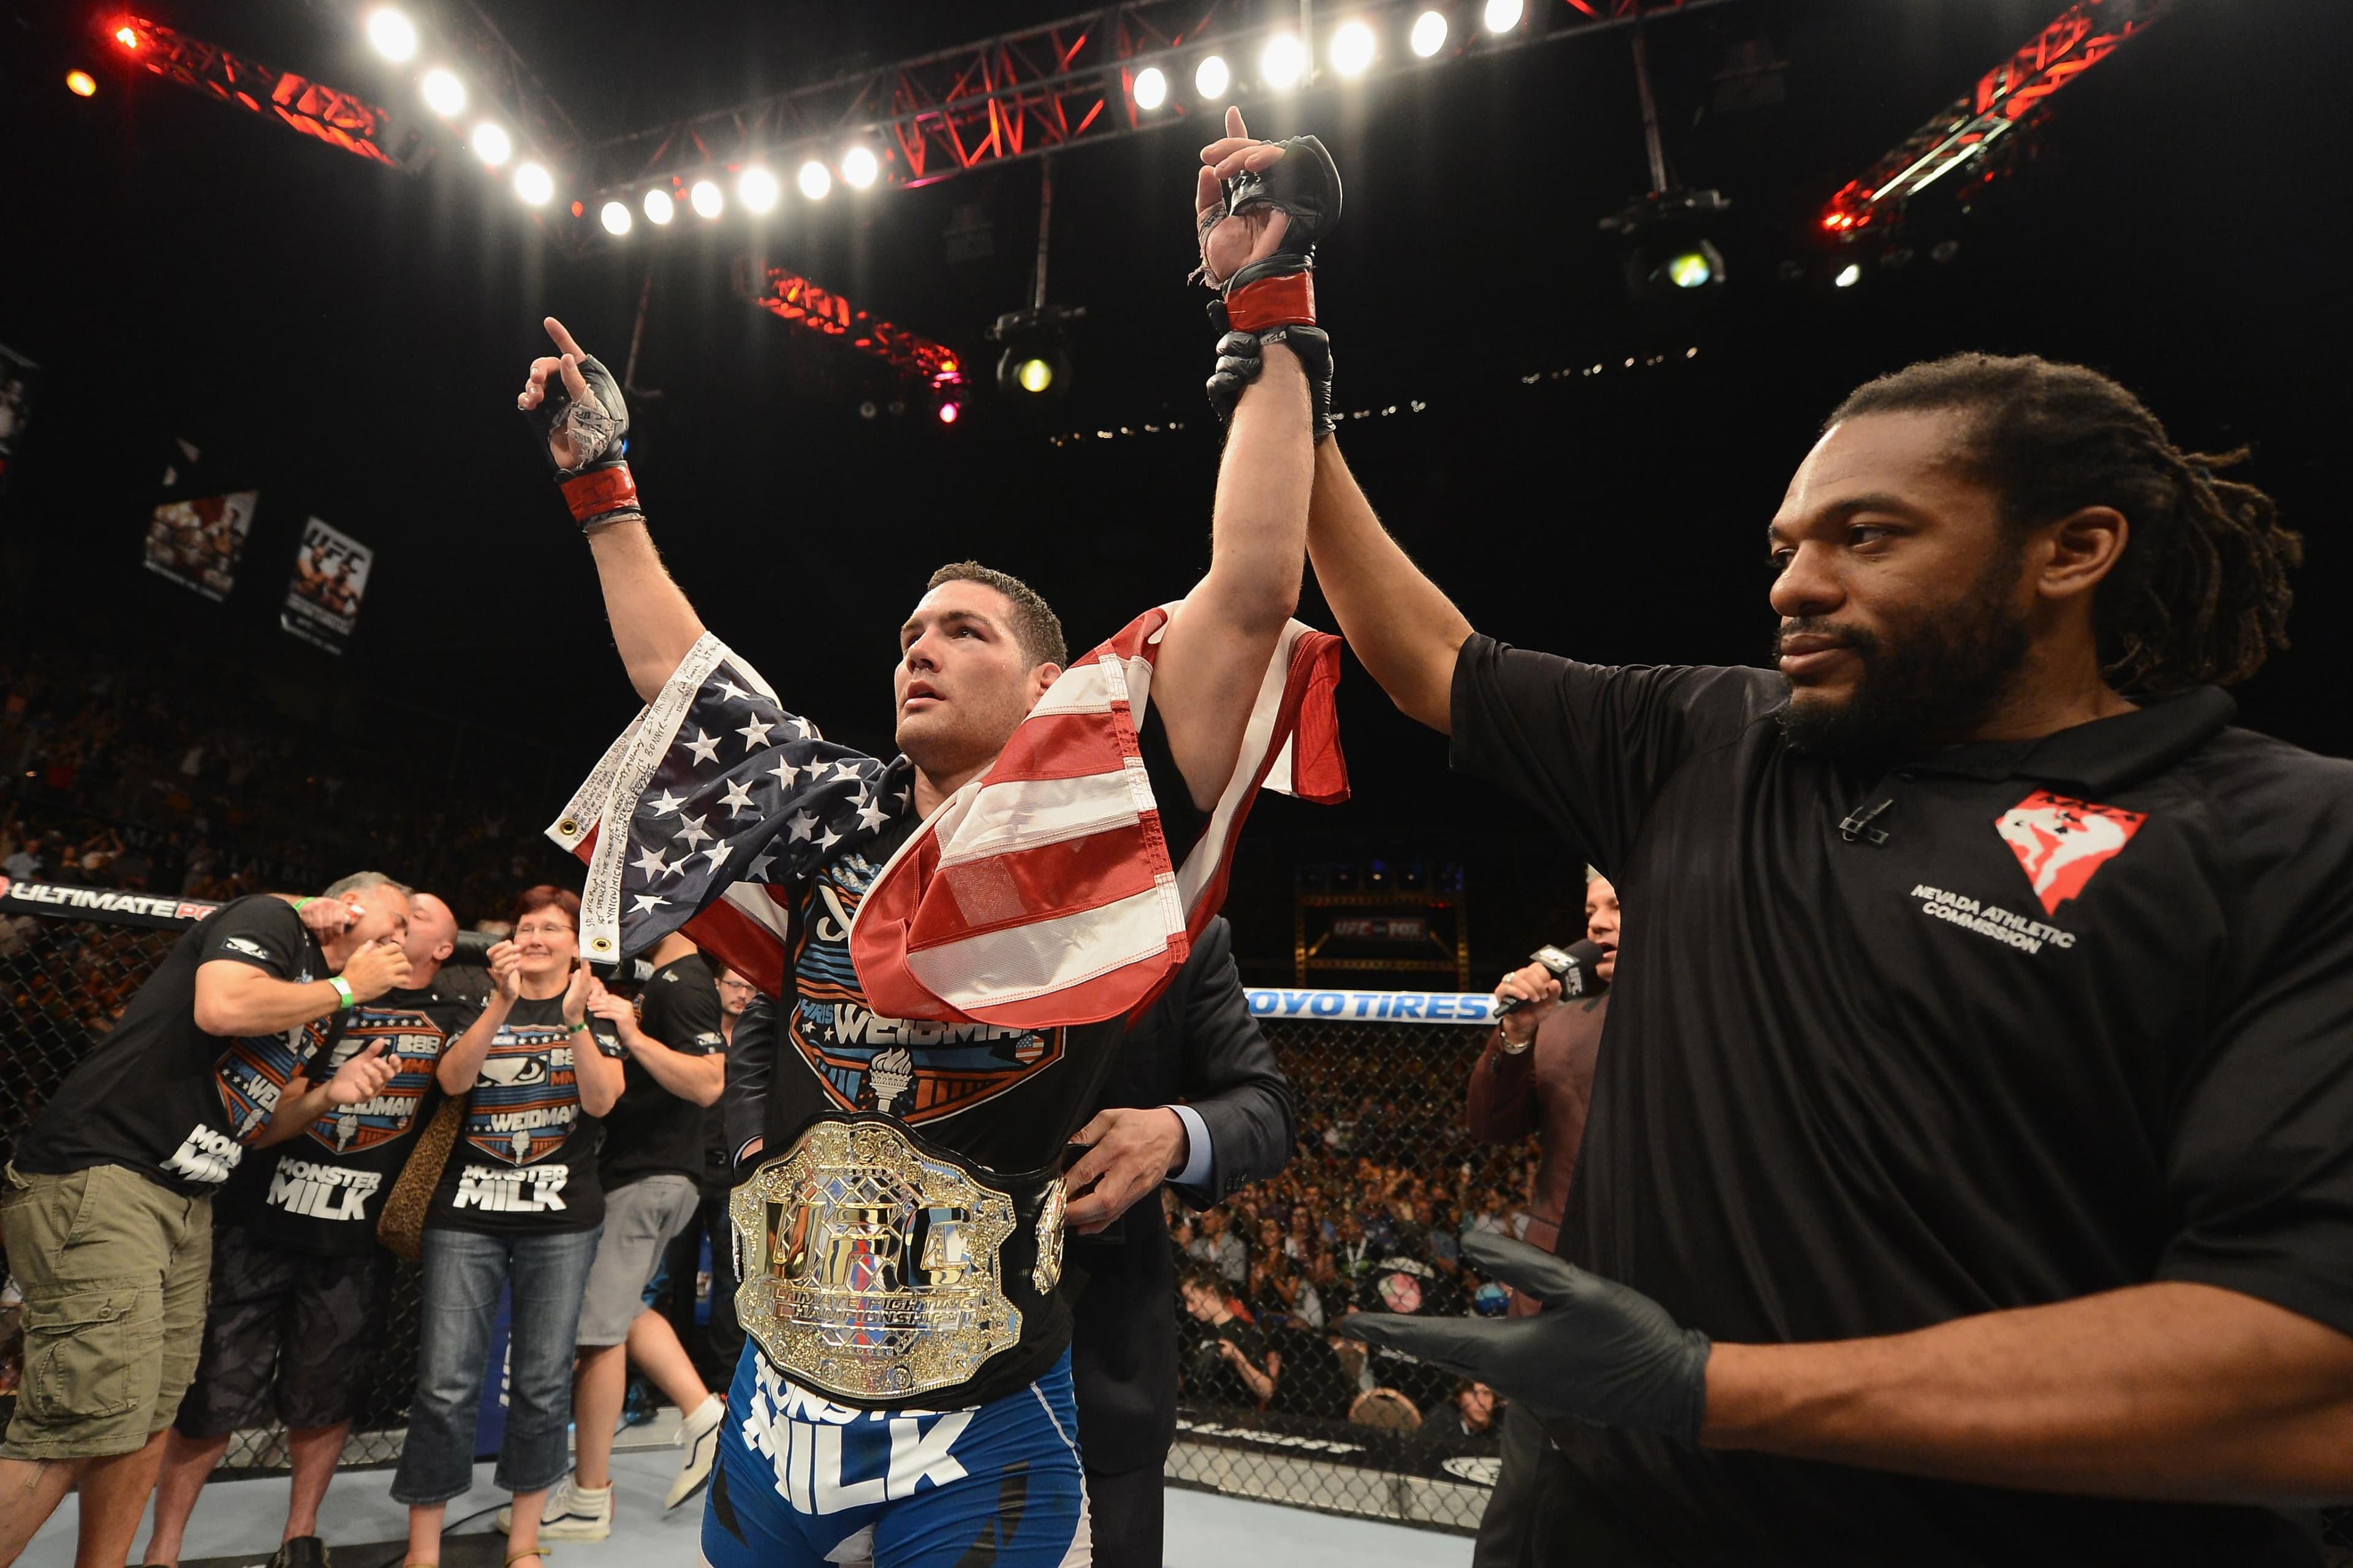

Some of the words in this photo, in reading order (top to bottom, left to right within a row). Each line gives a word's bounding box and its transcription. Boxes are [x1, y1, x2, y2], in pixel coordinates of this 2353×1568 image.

[643, 721, 667, 757] BONNER
[576, 787, 588, 799] YOU
[585, 769, 602, 787] EVEN
[599, 753, 613, 768] LIFT
[612, 733, 629, 753] BRO?
[1910, 884, 1980, 915] NEVADA
[1980, 906, 2077, 949] ATHLETIC
[1922, 901, 2042, 954] COMMISSION
[1244, 991, 1346, 1015] OYO
[1352, 994, 1490, 1020] TIRES
[186, 1123, 243, 1167] MON
[276, 1156, 382, 1189] MONSTER
[452, 1178, 567, 1212] MILK
[461, 1164, 569, 1183] MONSTER
[266, 1175, 378, 1221] MILK
[760, 1202, 973, 1286] UFC
[742, 1390, 976, 1515] MILK
